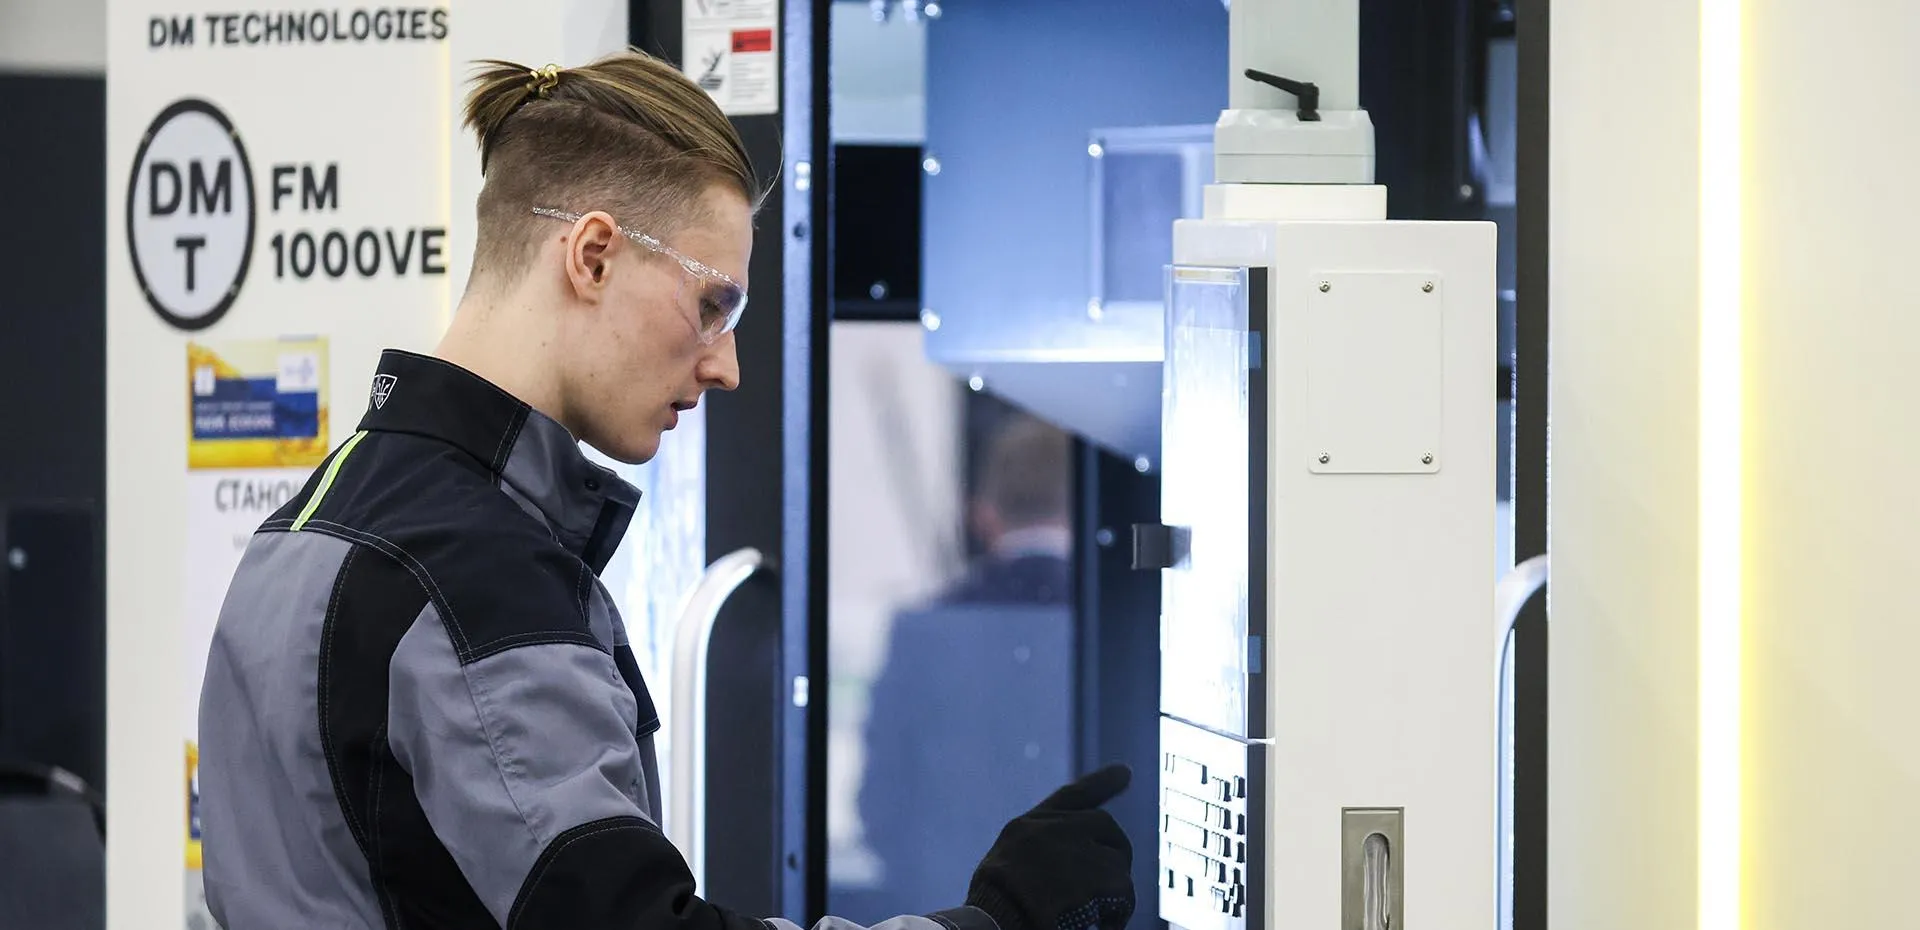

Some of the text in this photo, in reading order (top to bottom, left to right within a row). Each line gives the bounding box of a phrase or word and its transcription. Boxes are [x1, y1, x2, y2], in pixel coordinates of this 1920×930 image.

[149, 9, 449, 47] DM TECHNOLOGIES
[150, 159, 232, 216] DM
[272, 164, 338, 210] FM
[175, 237, 206, 292] T
[271, 229, 446, 278] 1000VE
